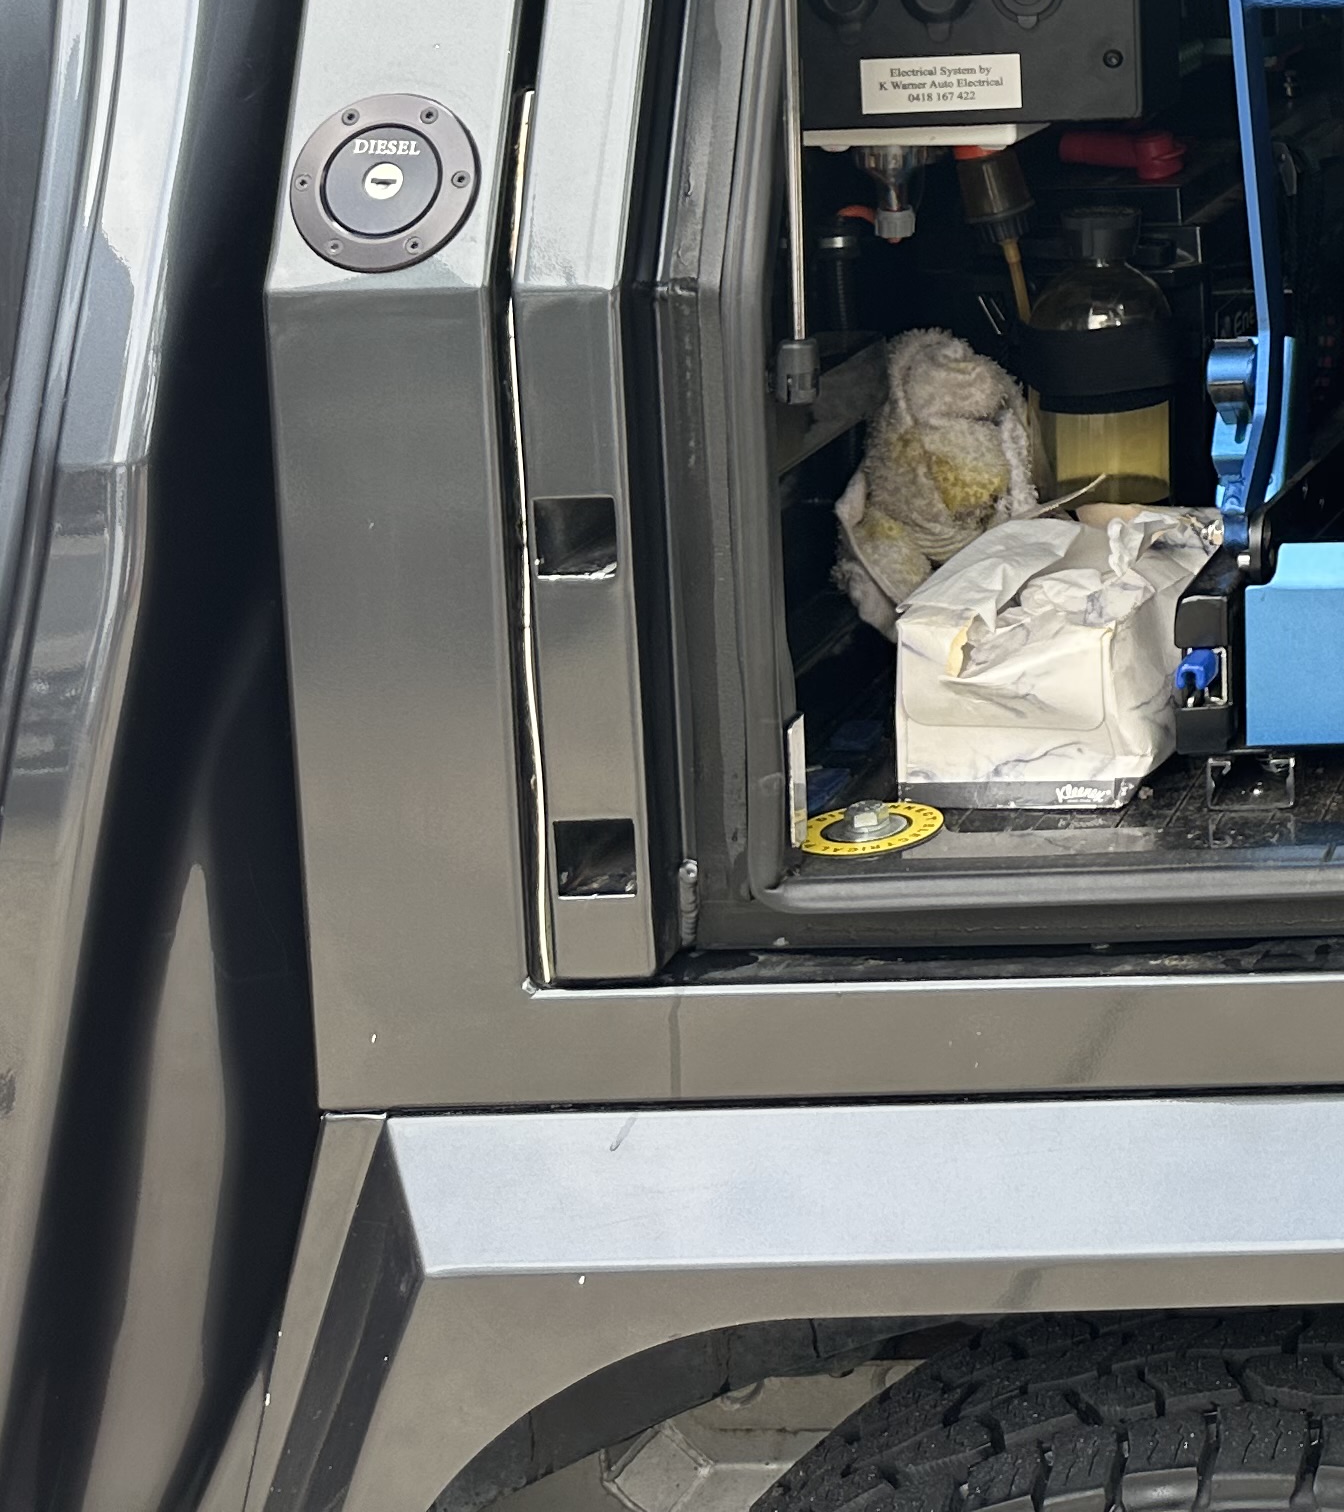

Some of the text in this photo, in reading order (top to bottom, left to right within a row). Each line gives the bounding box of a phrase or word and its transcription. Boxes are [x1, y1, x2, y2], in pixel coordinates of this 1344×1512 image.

[890, 65, 992, 77] Electrical System by
[879, 82, 888, 91] K
[930, 79, 954, 89] Auto
[957, 77, 1004, 88] Electrical
[908, 91, 976, 102] 0418 167 422
[353, 139, 421, 155] DIESEL
